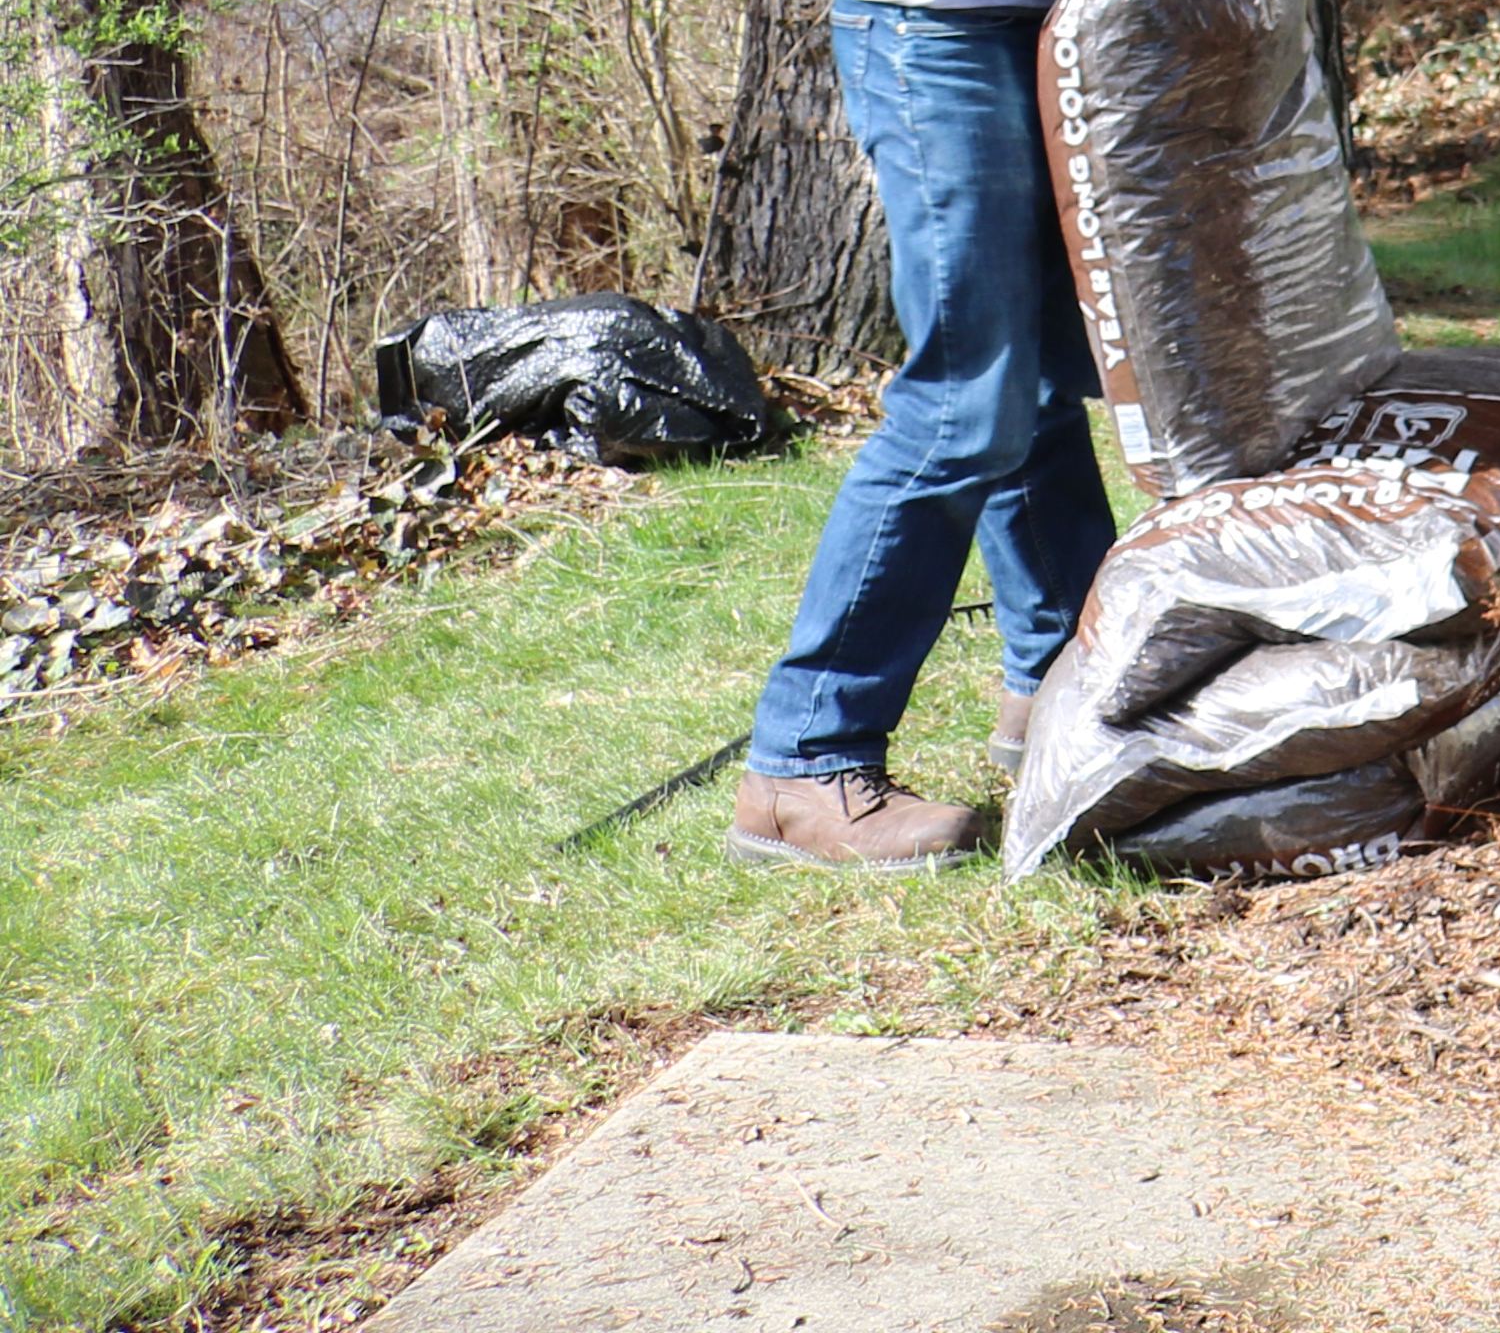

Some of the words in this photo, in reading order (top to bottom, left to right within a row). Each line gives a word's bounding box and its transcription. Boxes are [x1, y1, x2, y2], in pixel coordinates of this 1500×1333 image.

[1068, 152, 1105, 263] LONG
[1088, 269, 1129, 372] YEAR
[1206, 831, 1401, 879] BRO
